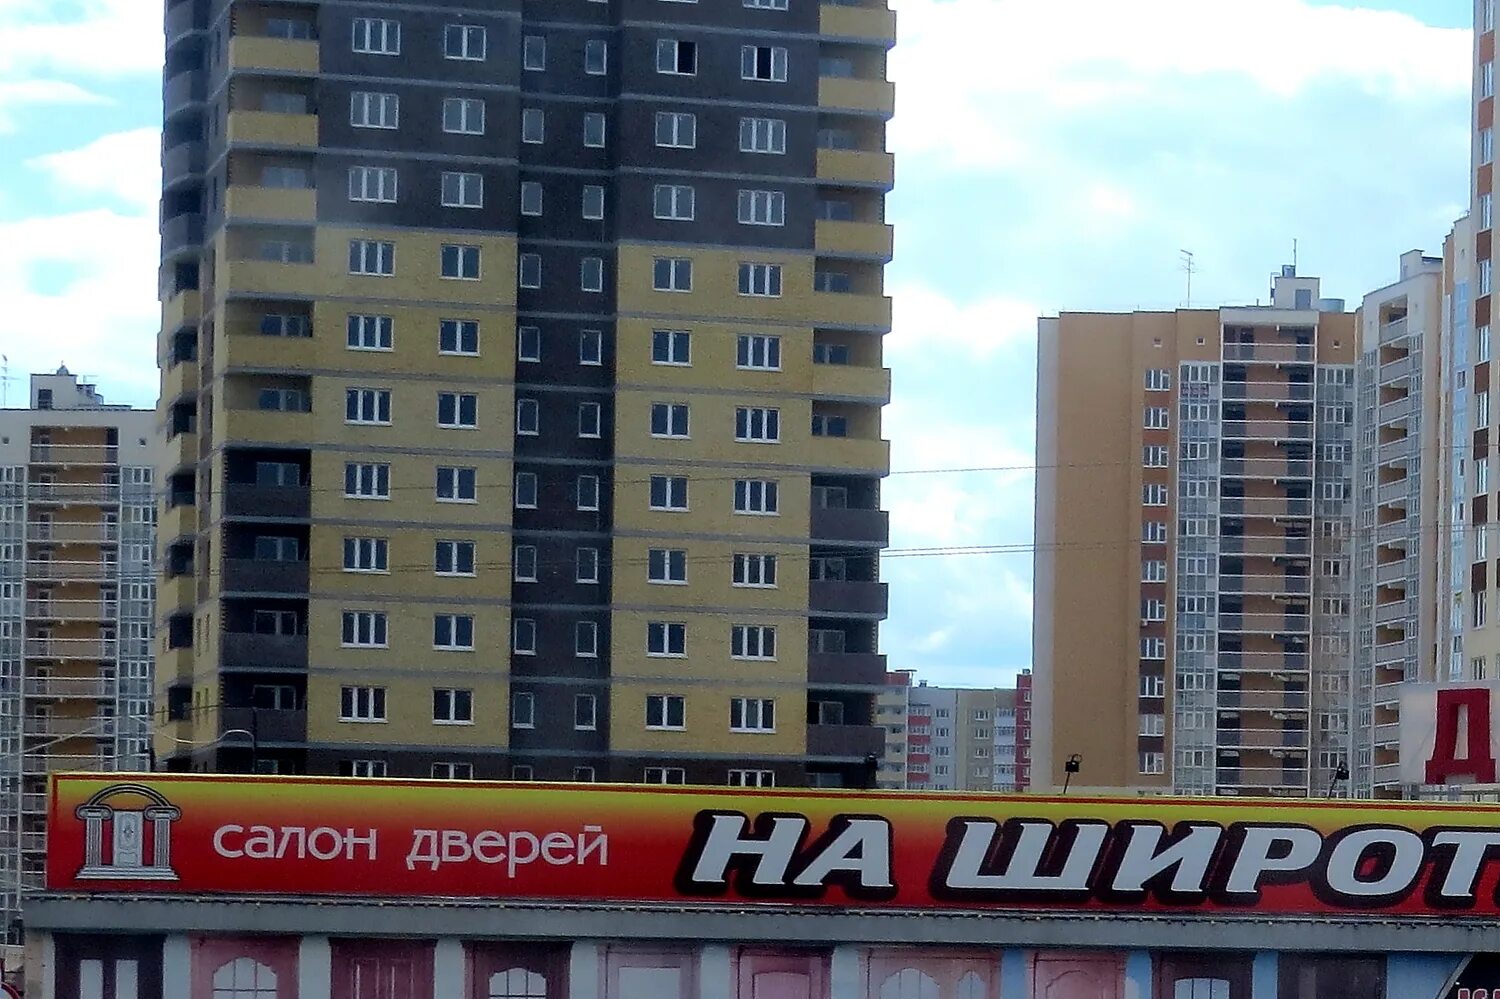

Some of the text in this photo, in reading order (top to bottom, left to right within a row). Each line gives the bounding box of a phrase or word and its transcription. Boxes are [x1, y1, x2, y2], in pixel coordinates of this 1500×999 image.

[213, 822, 609, 878] салон дверей
[692, 810, 897, 890] НА
